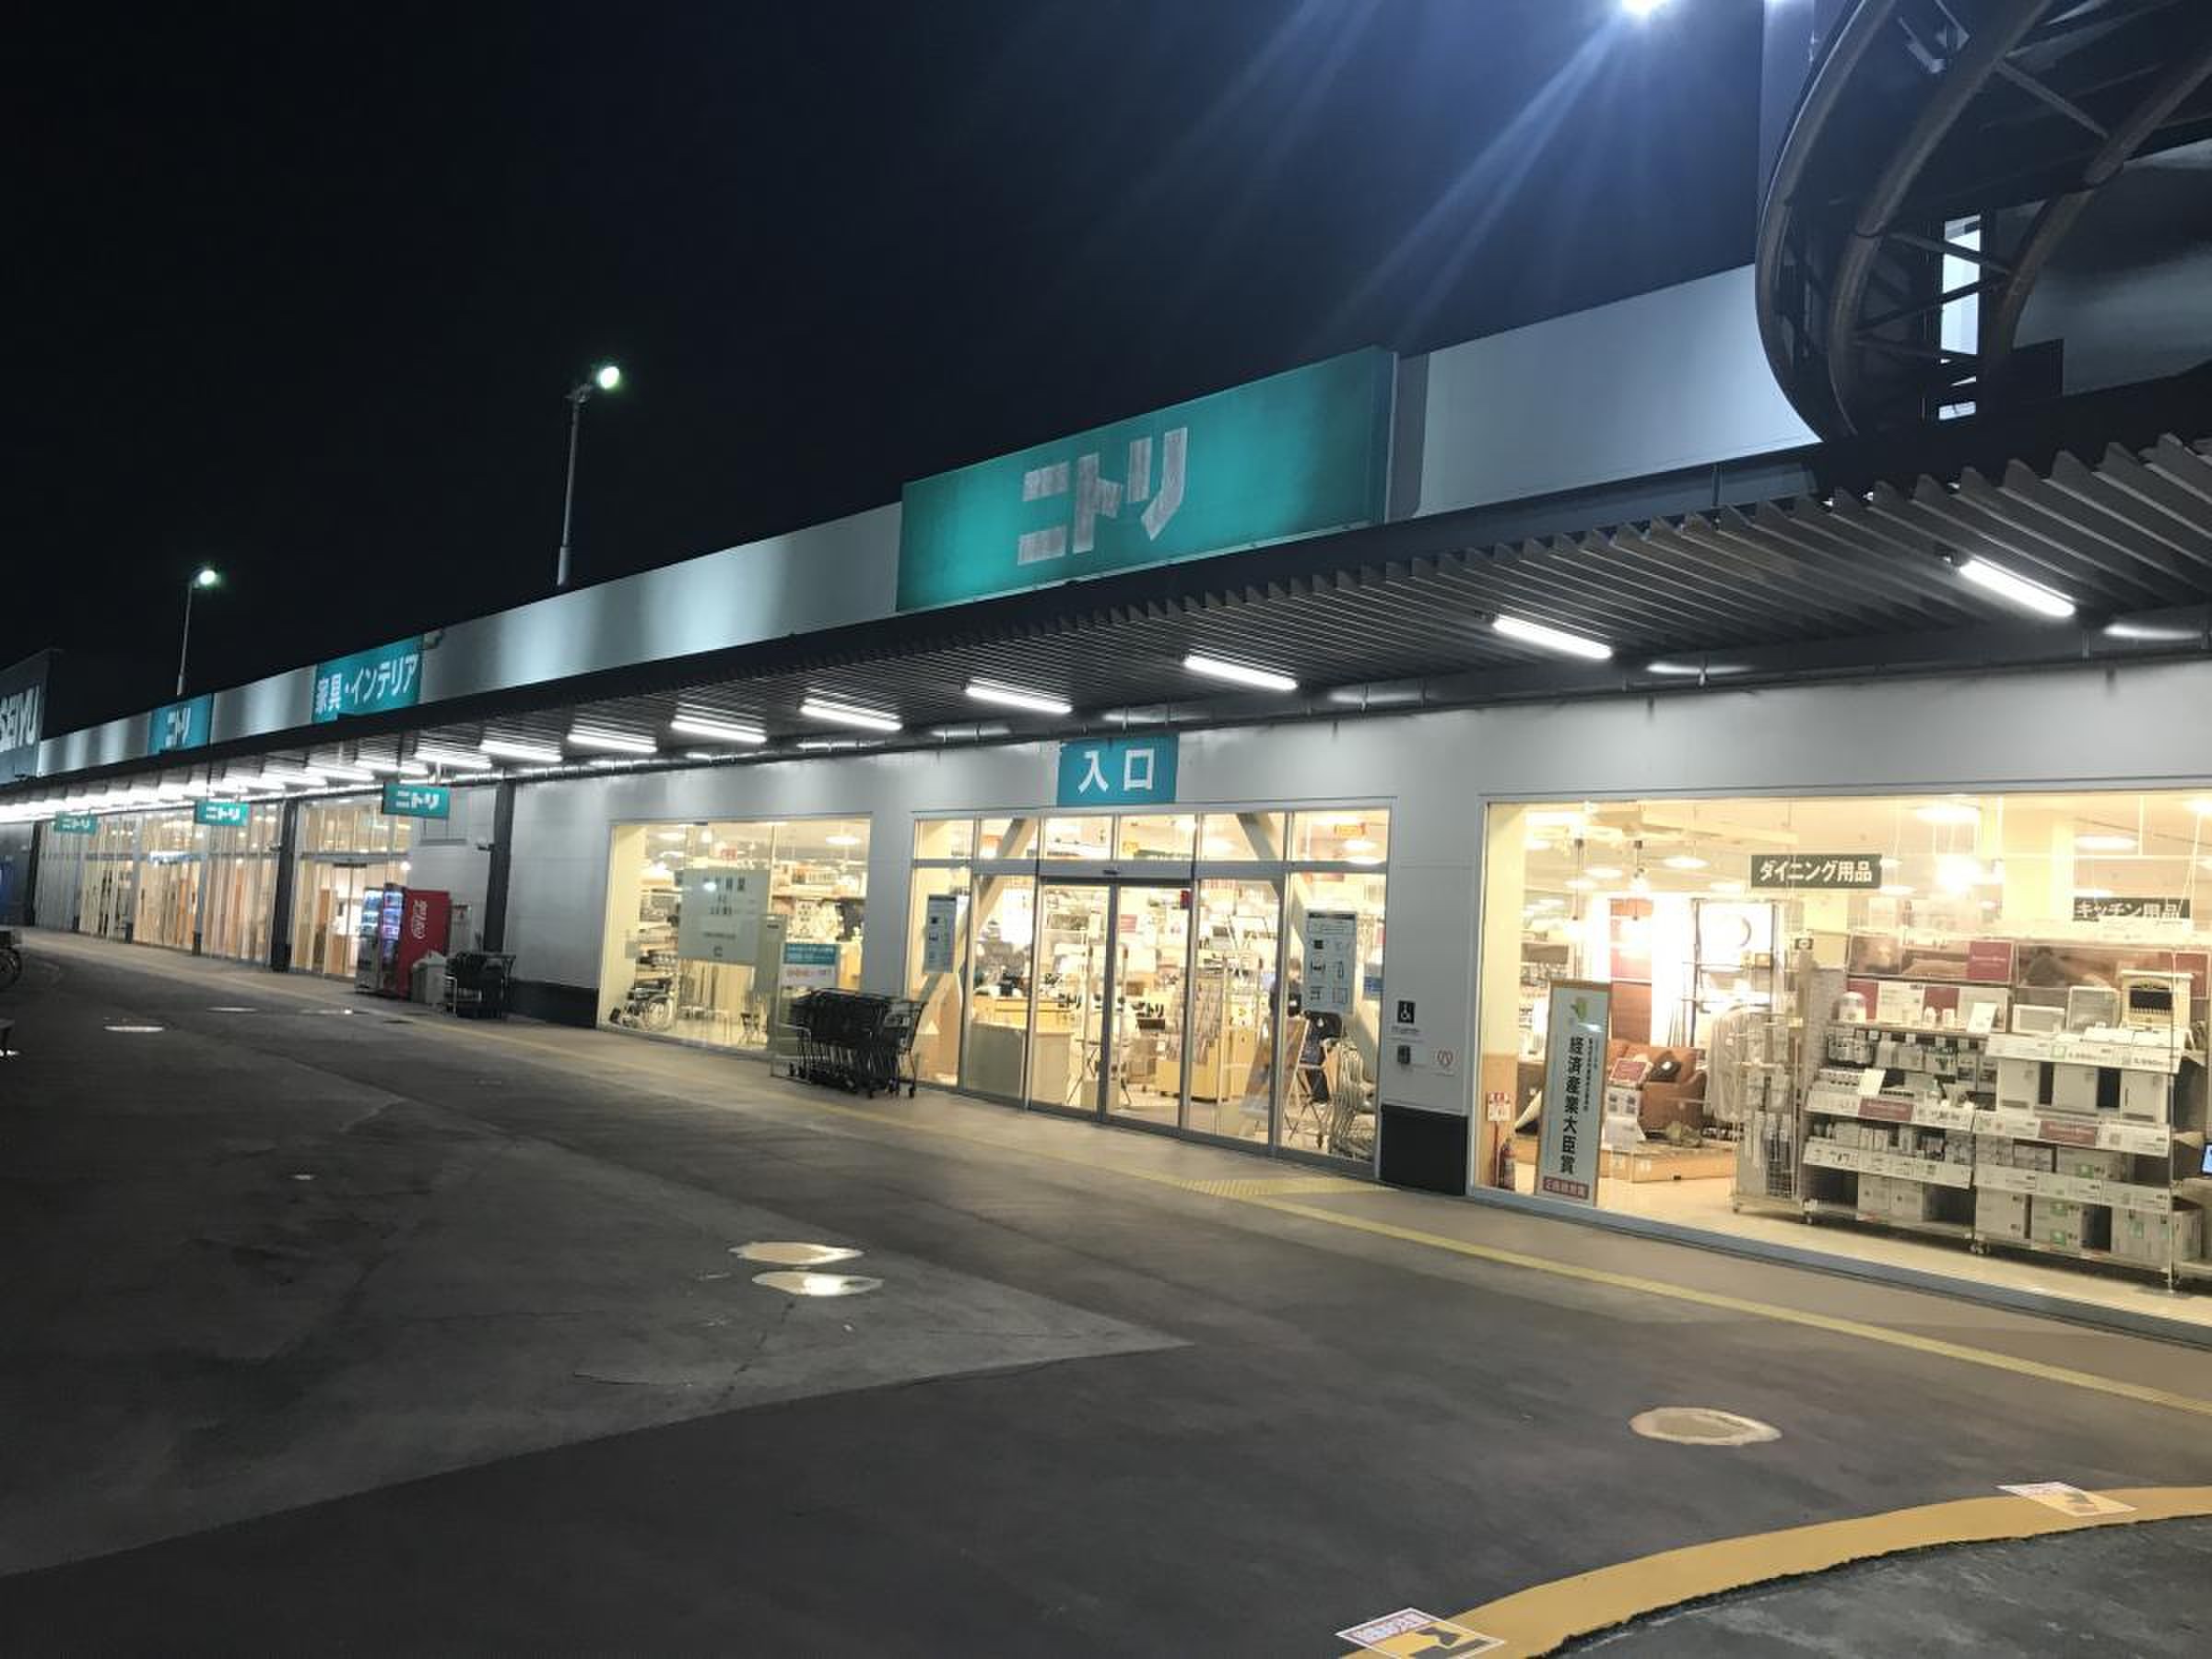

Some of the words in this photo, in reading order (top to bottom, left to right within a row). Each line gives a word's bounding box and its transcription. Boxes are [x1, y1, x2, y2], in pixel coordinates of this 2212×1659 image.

[1018, 427, 1188, 566] ニトリ
[1077, 747, 1155, 794] 入口
[395, 790, 440, 810] ニトリ
[206, 807, 241, 819] ニトリ
[1759, 859, 1873, 883] ダイニング用品
